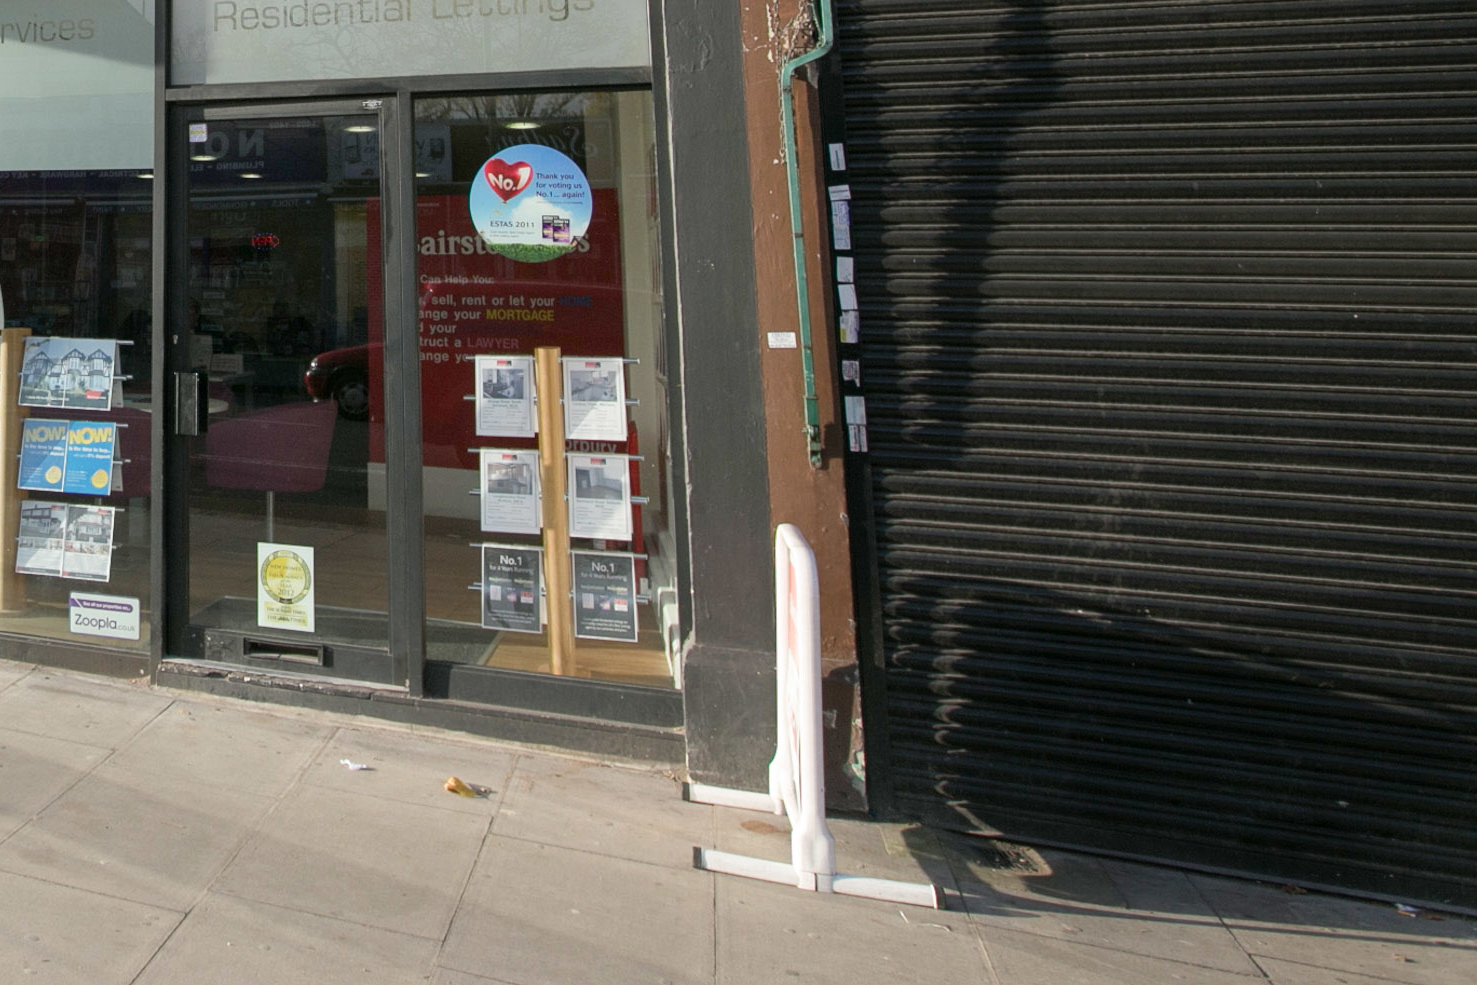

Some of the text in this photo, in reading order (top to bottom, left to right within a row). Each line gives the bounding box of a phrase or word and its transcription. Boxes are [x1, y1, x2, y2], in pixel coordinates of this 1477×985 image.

[488, 167, 531, 191] No.1
[549, 182, 571, 190] voting
[562, 191, 585, 199] again!
[420, 275, 494, 286] Can Help You:
[432, 295, 456, 306] sell,
[462, 296, 486, 306] rent
[492, 297, 504, 306] or
[509, 296, 524, 306] let
[530, 298, 555, 309] your
[454, 311, 481, 322] your
[486, 309, 555, 322] MORTGAGE
[430, 324, 456, 335] your
[467, 338, 519, 349] LAWYER
[24, 425, 66, 443] NOW!
[68, 427, 113, 445] NOW!
[500, 555, 522, 566] No.1
[513, 566, 534, 576] Running
[592, 562, 615, 573] No.1
[607, 573, 628, 582] Running
